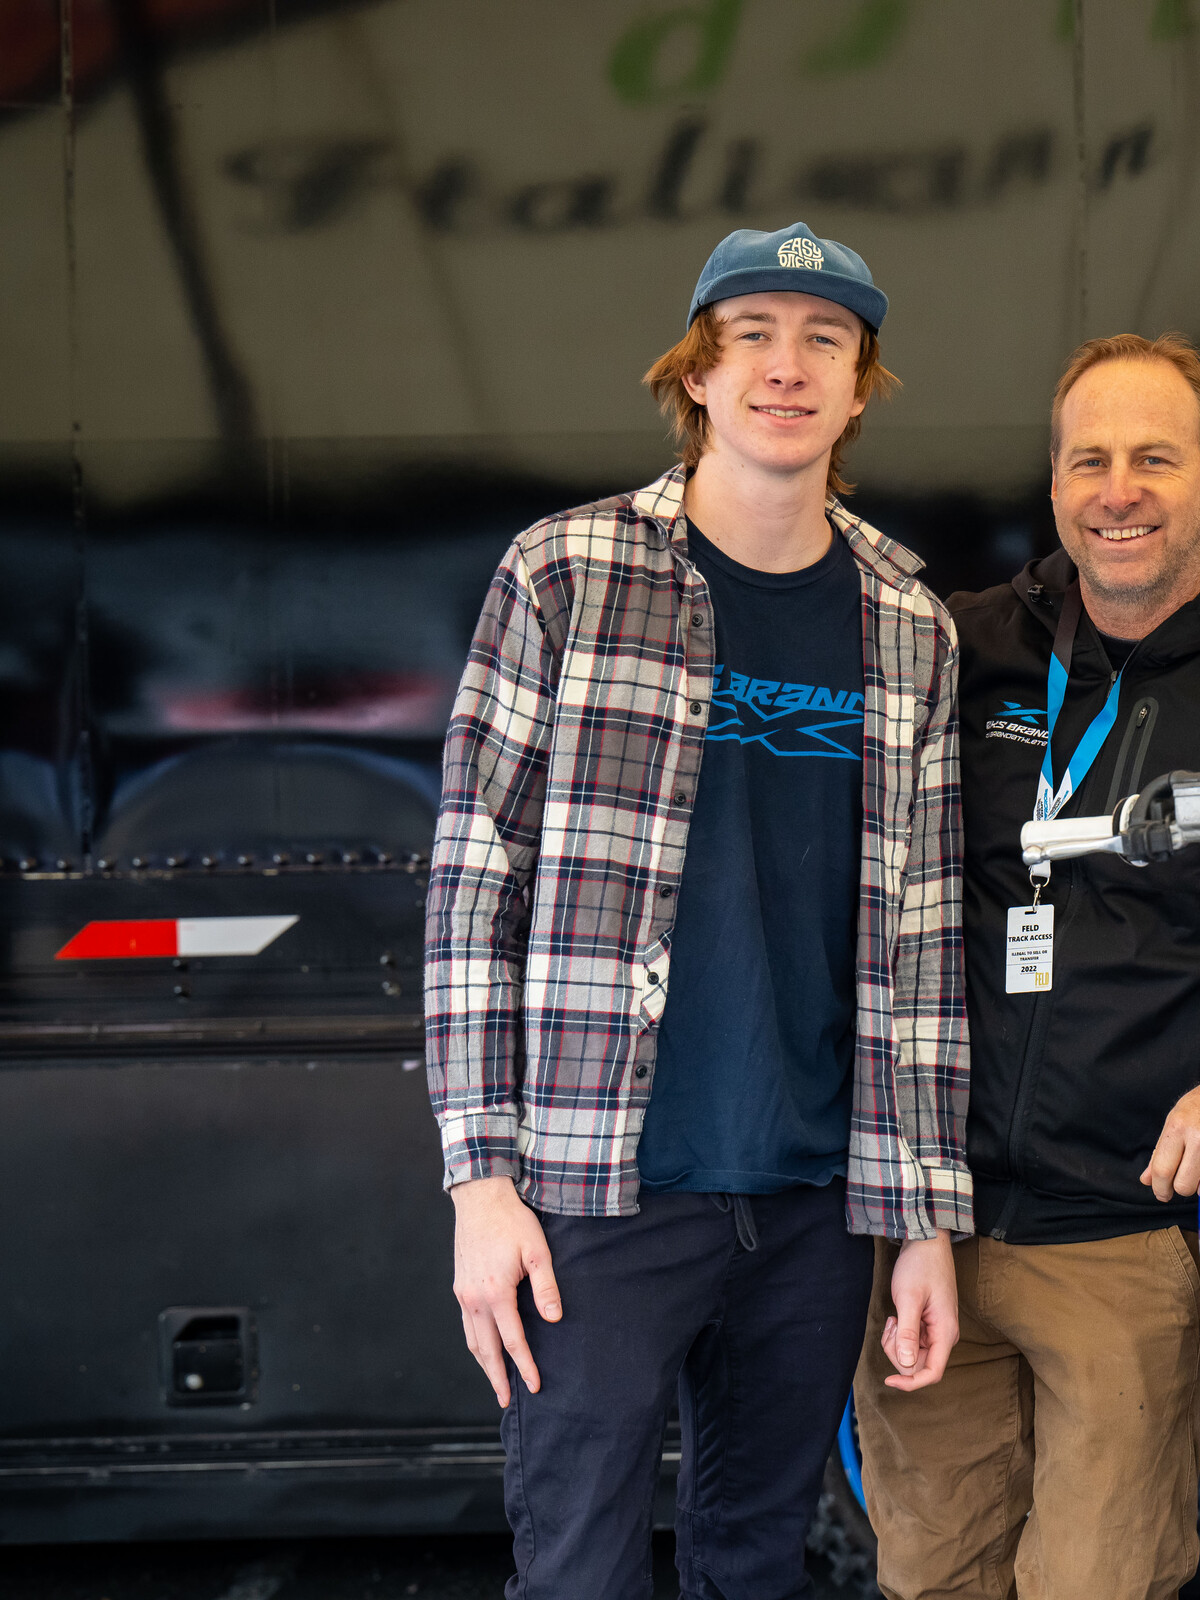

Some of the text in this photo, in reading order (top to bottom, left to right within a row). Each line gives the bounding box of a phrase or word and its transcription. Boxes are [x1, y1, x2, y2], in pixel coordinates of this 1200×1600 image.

[778, 237, 822, 257] EASY
[1030, 933, 1052, 941] ACCESS
[1035, 972, 1049, 986] FELD
